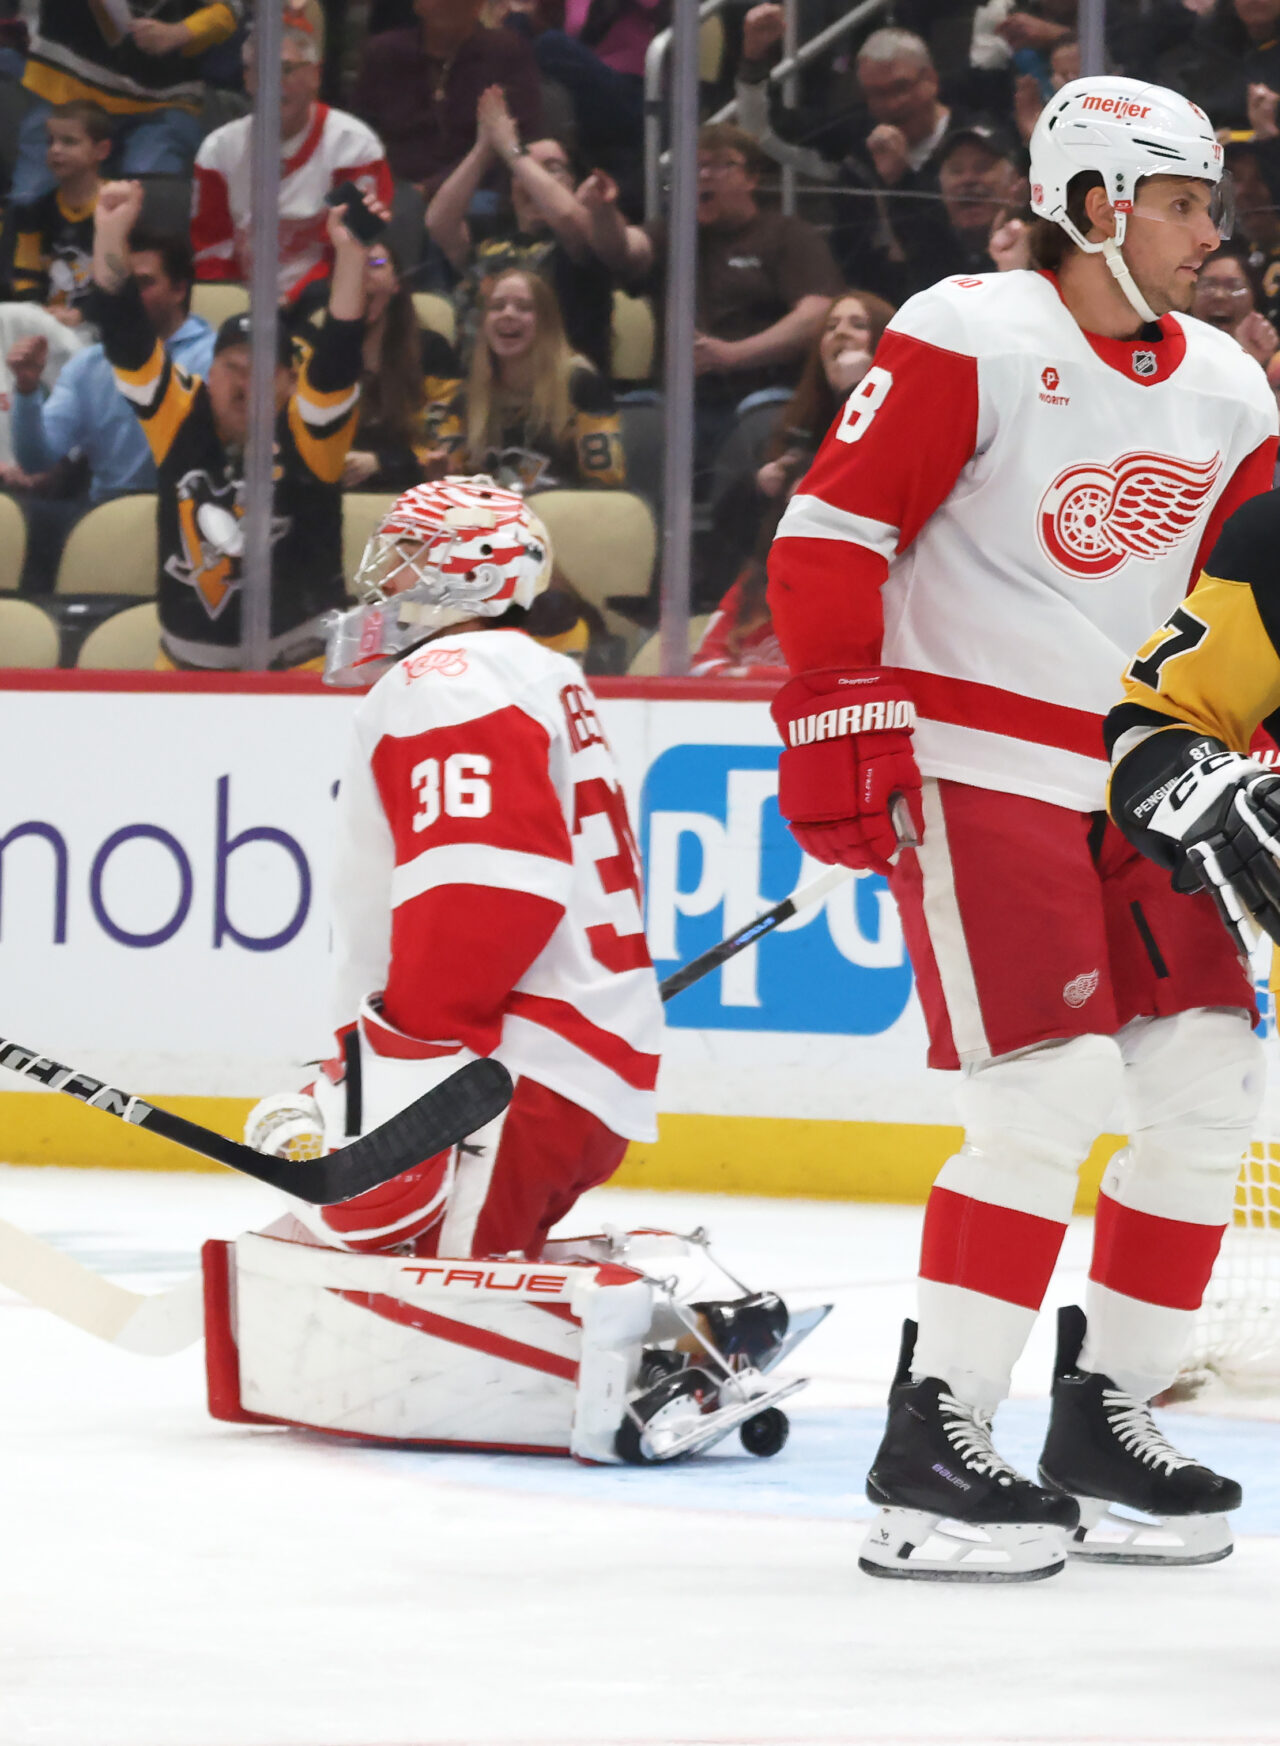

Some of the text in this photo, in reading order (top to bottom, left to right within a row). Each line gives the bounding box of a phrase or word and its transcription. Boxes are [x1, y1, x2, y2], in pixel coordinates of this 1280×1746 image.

[1189, 741, 1212, 761] 87
[411, 753, 491, 834] 36
[1168, 752, 1250, 812] CC
[0, 772, 341, 953] mob
[401, 1257, 568, 1293] TRUE
